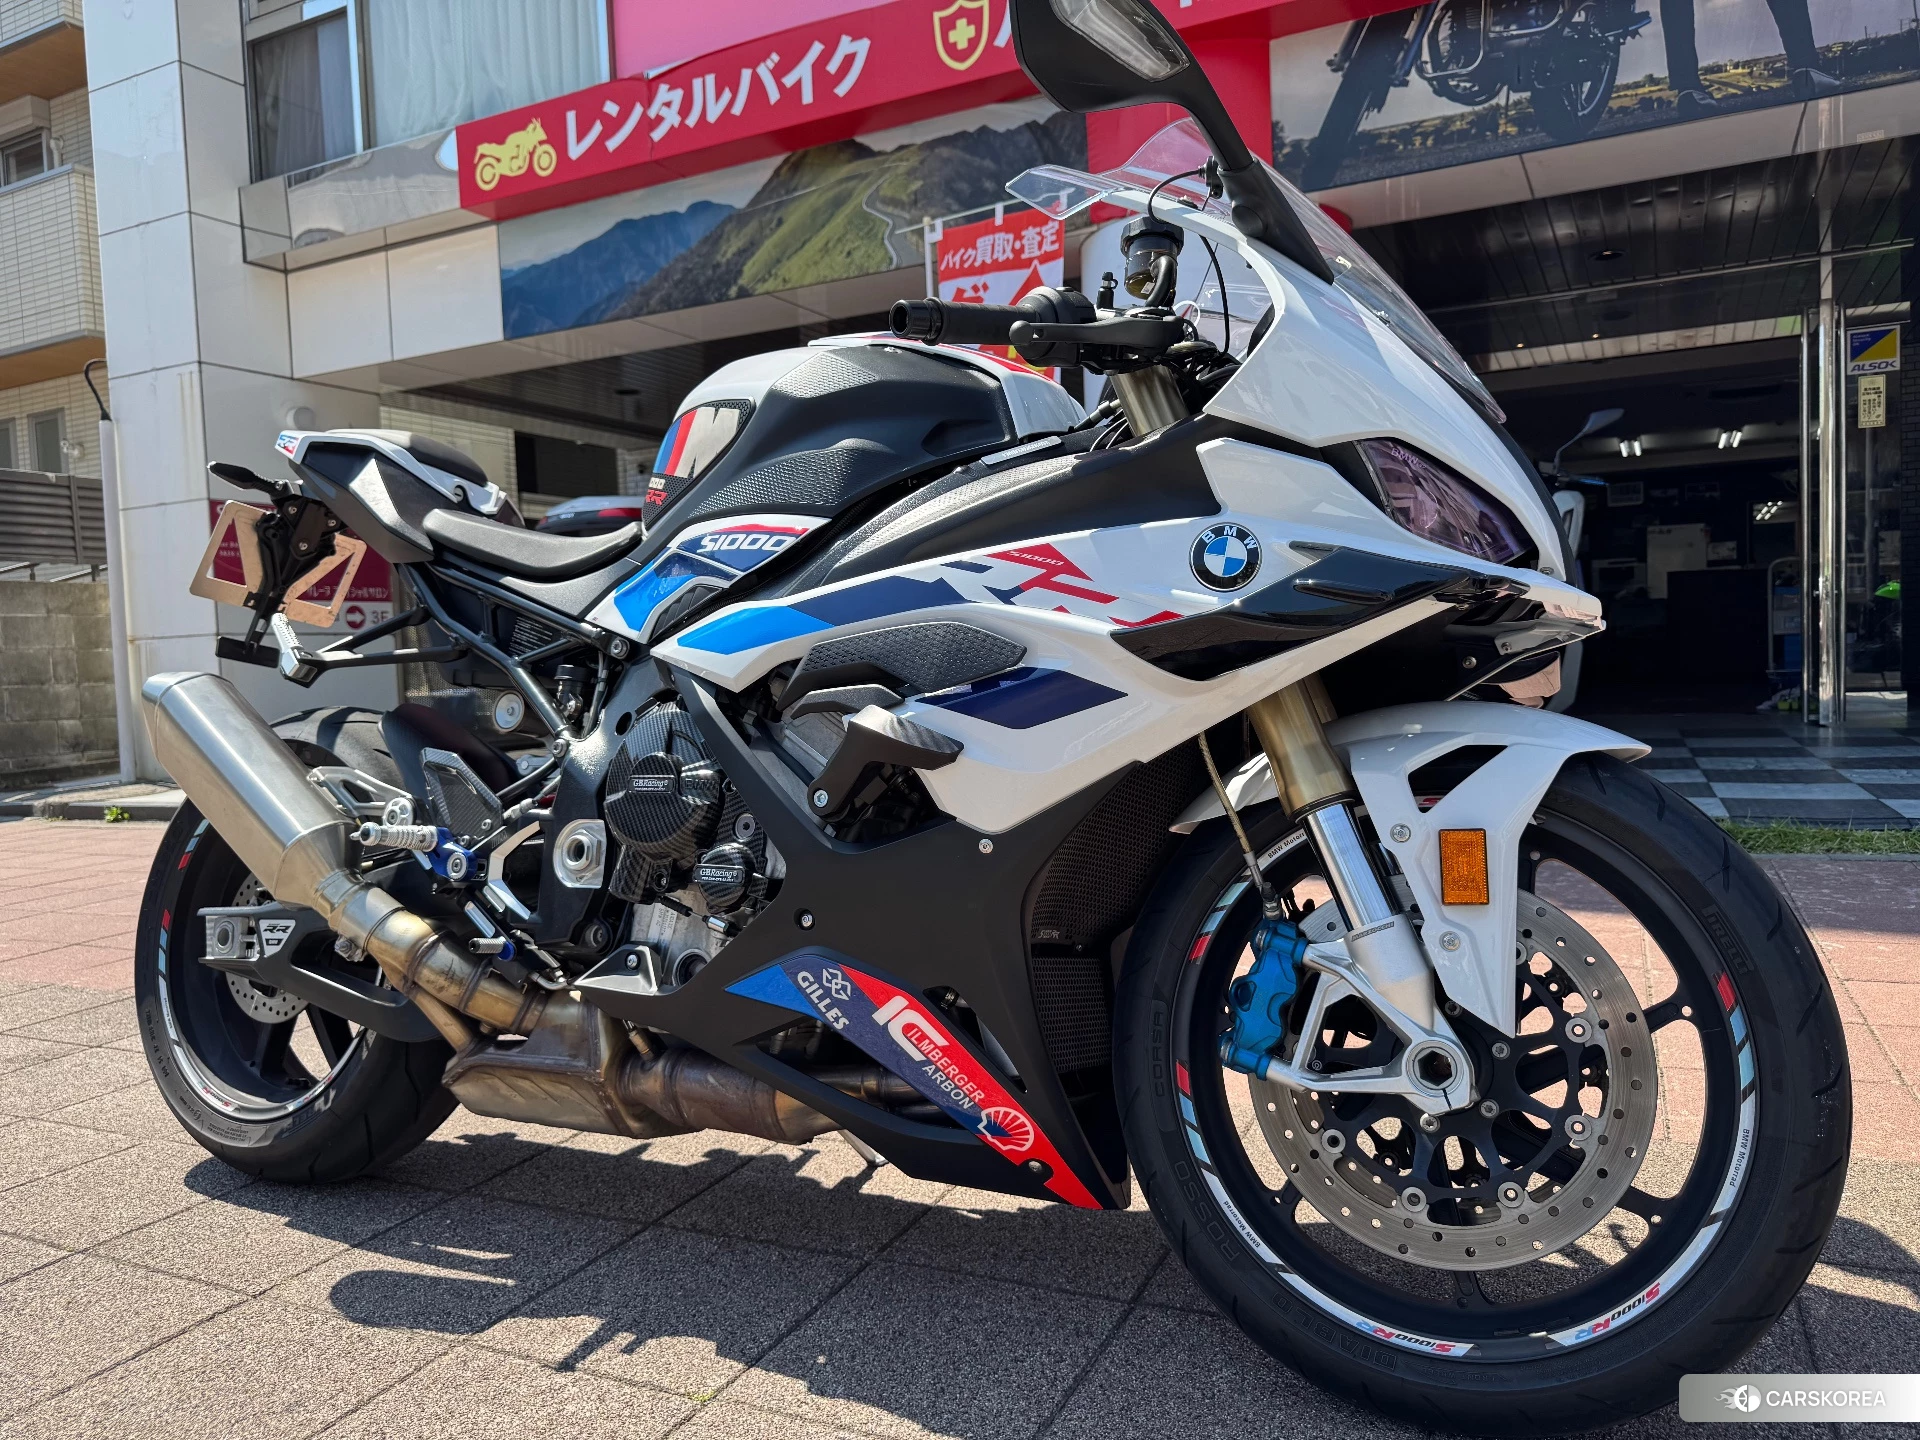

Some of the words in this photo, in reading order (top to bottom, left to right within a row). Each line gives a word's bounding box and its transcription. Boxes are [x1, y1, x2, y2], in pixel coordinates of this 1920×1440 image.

[565, 34, 872, 162] レンタルバイク
[1850, 360, 1897, 372] ALSOK
[1391, 448, 1419, 465] BMW
[697, 533, 797, 553] S1000
[1201, 525, 1258, 549] BMW
[1267, 842, 1284, 859] BMW
[1701, 903, 1754, 975] PIRELLI
[797, 971, 850, 1030] GILLES
[907, 1027, 985, 1103] ILMBERGER
[1154, 1009, 1164, 1097] CORSA
[921, 1064, 975, 1110] ARBON
[1741, 1128, 1751, 1150] BMW
[1729, 1150, 1747, 1187] Motorrad
[1174, 1160, 1240, 1262] ROSSO
[1222, 1200, 1247, 1233] Motorrad
[1243, 1227, 1261, 1249] BMW
[1271, 1290, 1397, 1370] DIABLO
[1574, 1282, 1661, 1341] S1000RR
[1355, 1320, 1456, 1353] S1000RR
